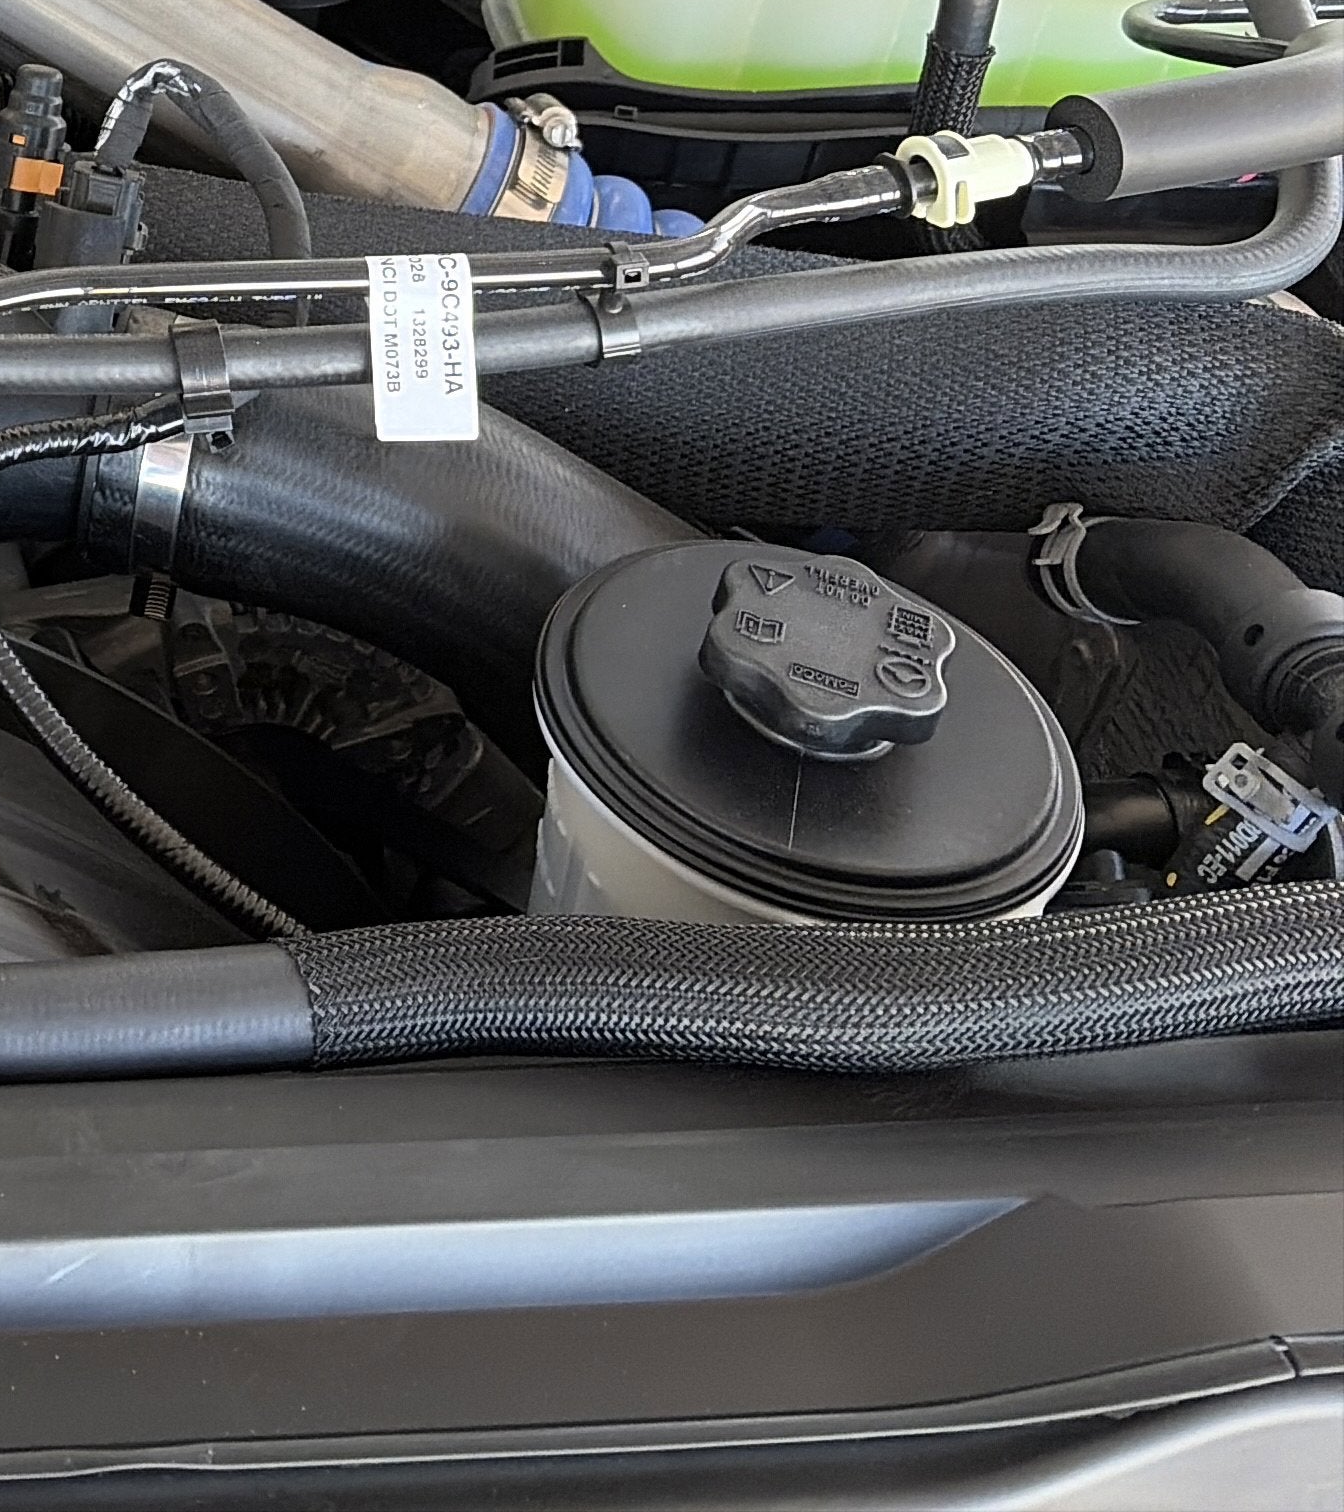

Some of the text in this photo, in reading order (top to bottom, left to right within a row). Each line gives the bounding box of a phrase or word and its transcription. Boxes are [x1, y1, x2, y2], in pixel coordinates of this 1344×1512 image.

[411, 308, 430, 380] 1328299
[437, 254, 464, 396] C-9C493-HA
[383, 333, 402, 393] M073B
[804, 564, 881, 597] OVERFILL
[851, 592, 872, 609] DO
[793, 663, 859, 696] FoMoCo
